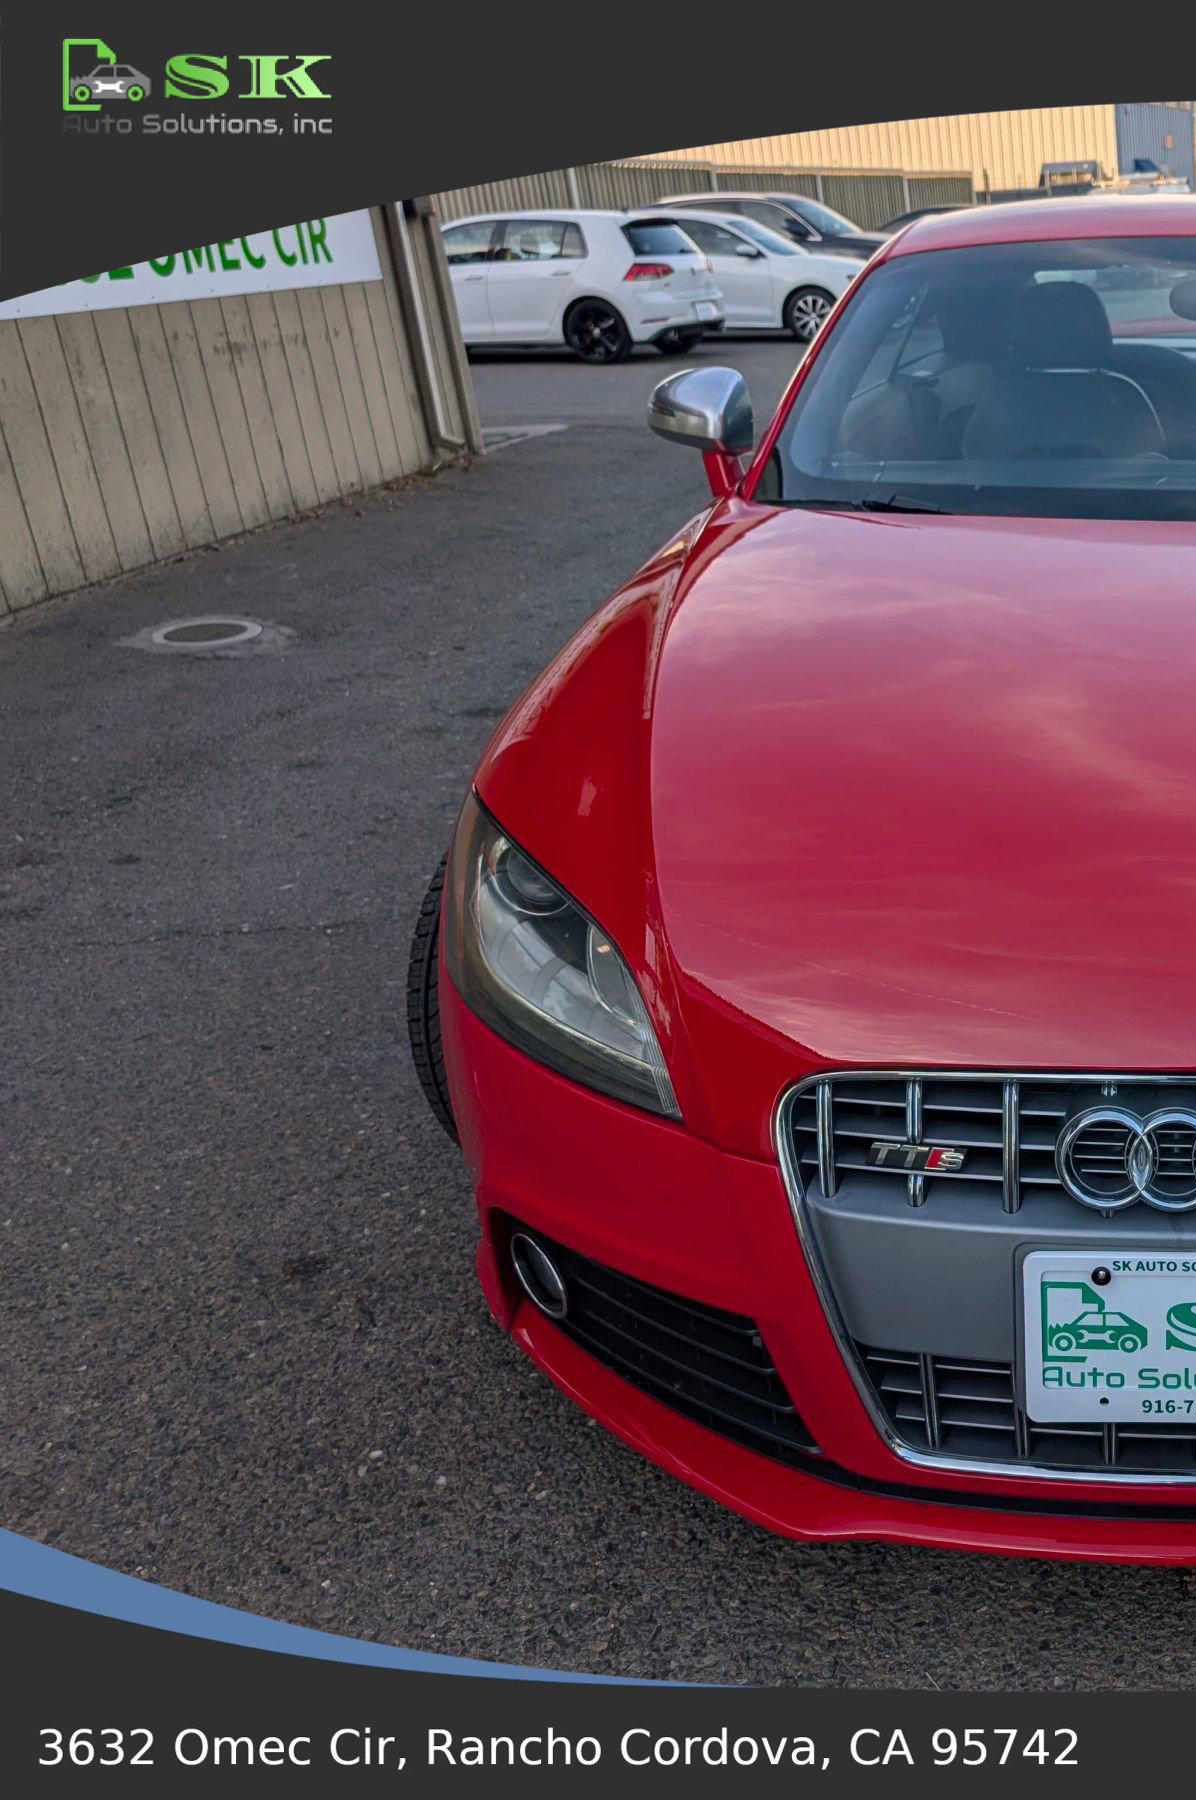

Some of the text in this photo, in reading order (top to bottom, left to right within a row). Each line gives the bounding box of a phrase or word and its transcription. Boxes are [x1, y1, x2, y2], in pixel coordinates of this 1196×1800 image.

[272, 217, 333, 267] CIR
[870, 1142, 966, 1171] TTS
[1112, 1260, 1132, 1272] SK
[1135, 1260, 1178, 1272] AUTO
[1042, 1366, 1125, 1389] Auto
